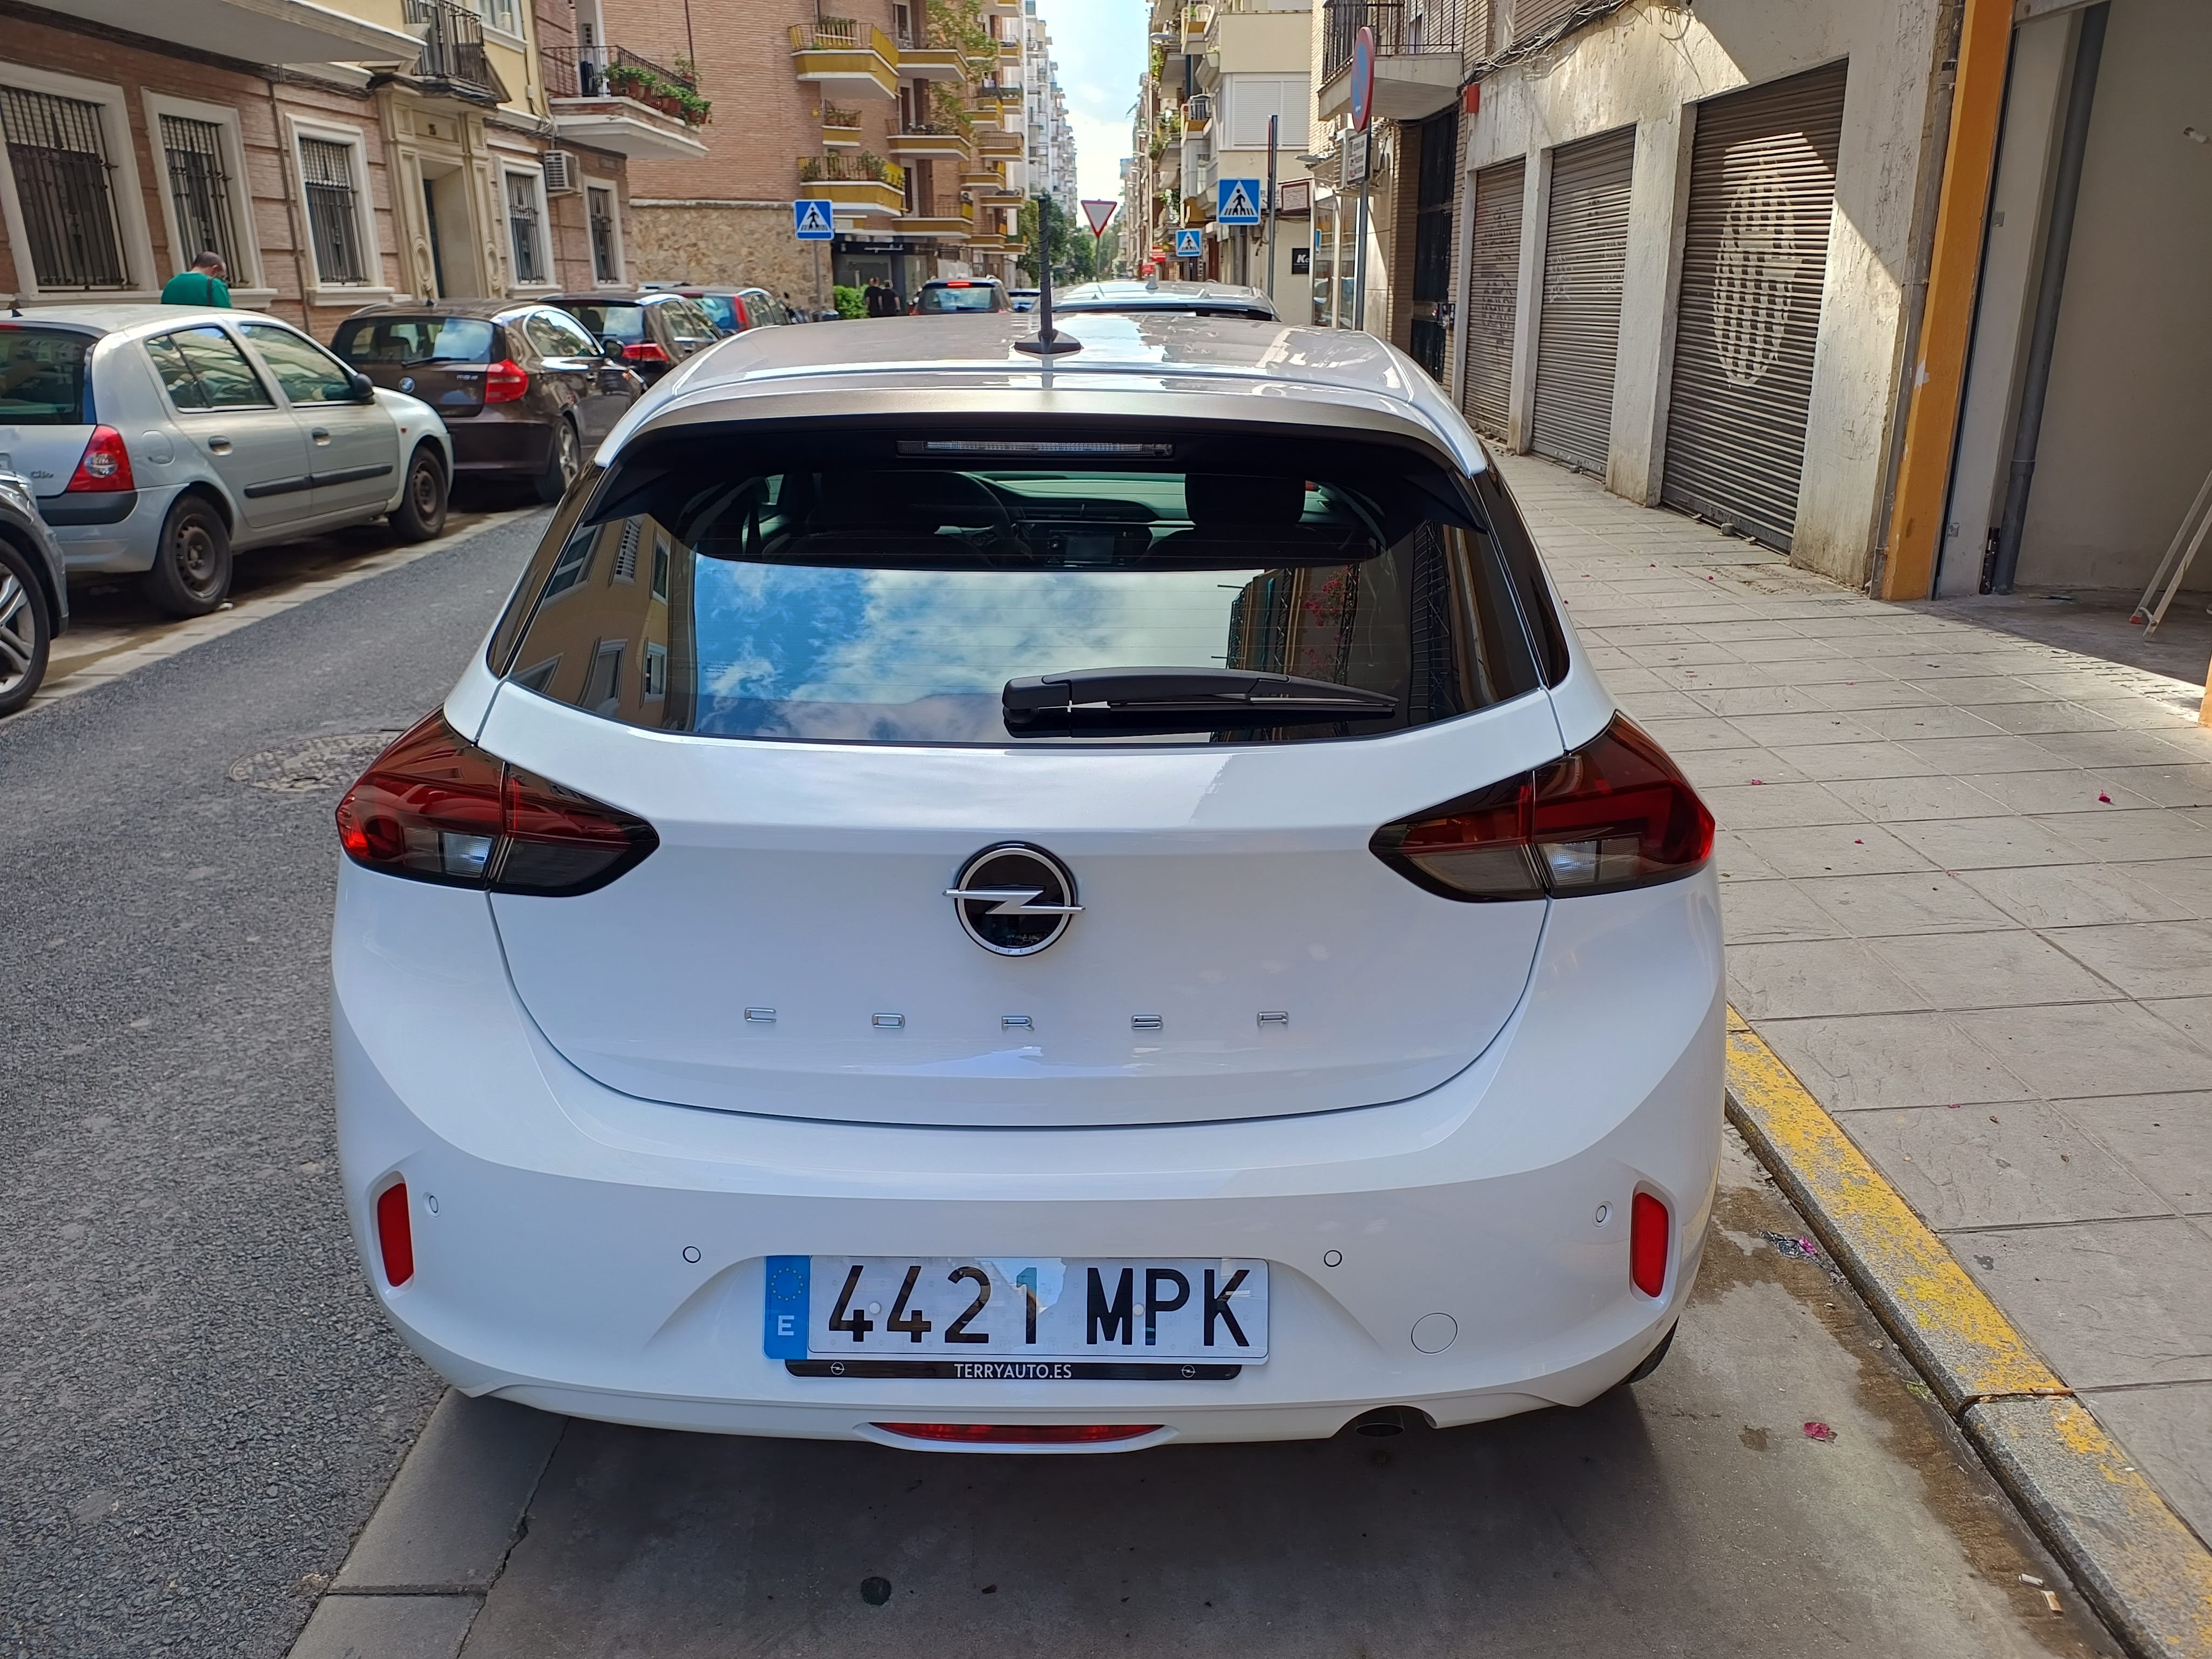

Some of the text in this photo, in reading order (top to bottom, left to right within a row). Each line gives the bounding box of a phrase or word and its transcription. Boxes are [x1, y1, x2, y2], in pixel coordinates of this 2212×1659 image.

[744, 1007, 1289, 1030] CORSA
[829, 1265, 1250, 1346] 4421 MPK
[778, 1316, 794, 1336] E
[954, 1364, 1072, 1378] TERRYAUTO.ES
